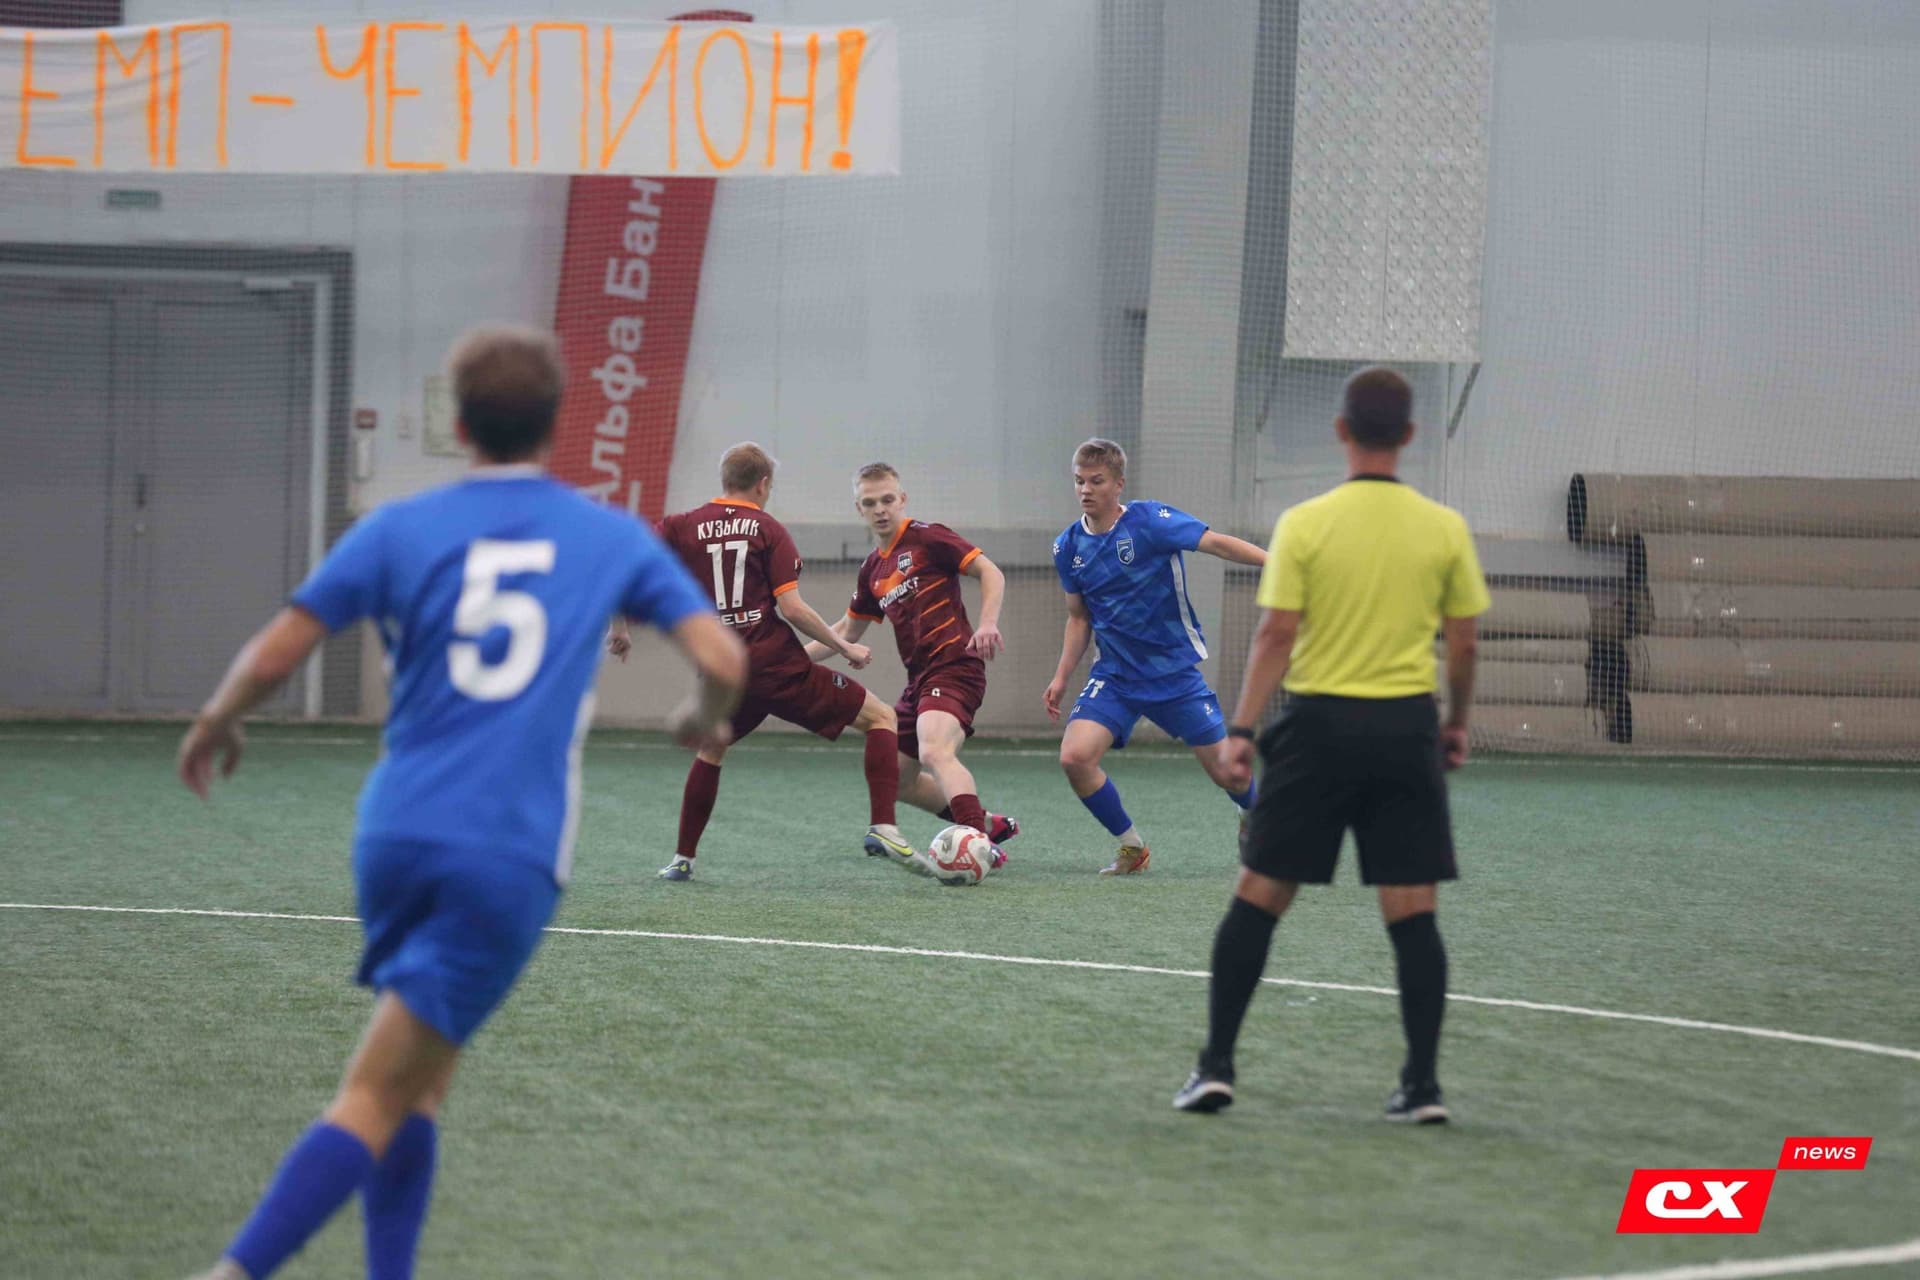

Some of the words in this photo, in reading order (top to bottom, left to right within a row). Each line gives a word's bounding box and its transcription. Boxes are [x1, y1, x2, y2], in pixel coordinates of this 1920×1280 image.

[316, 23, 866, 171] ЧЕМПИОН!
[604, 177, 665, 301] Бан
[448, 539, 556, 702] 5
[706, 540, 749, 611] 17
[721, 608, 762, 626] EUS
